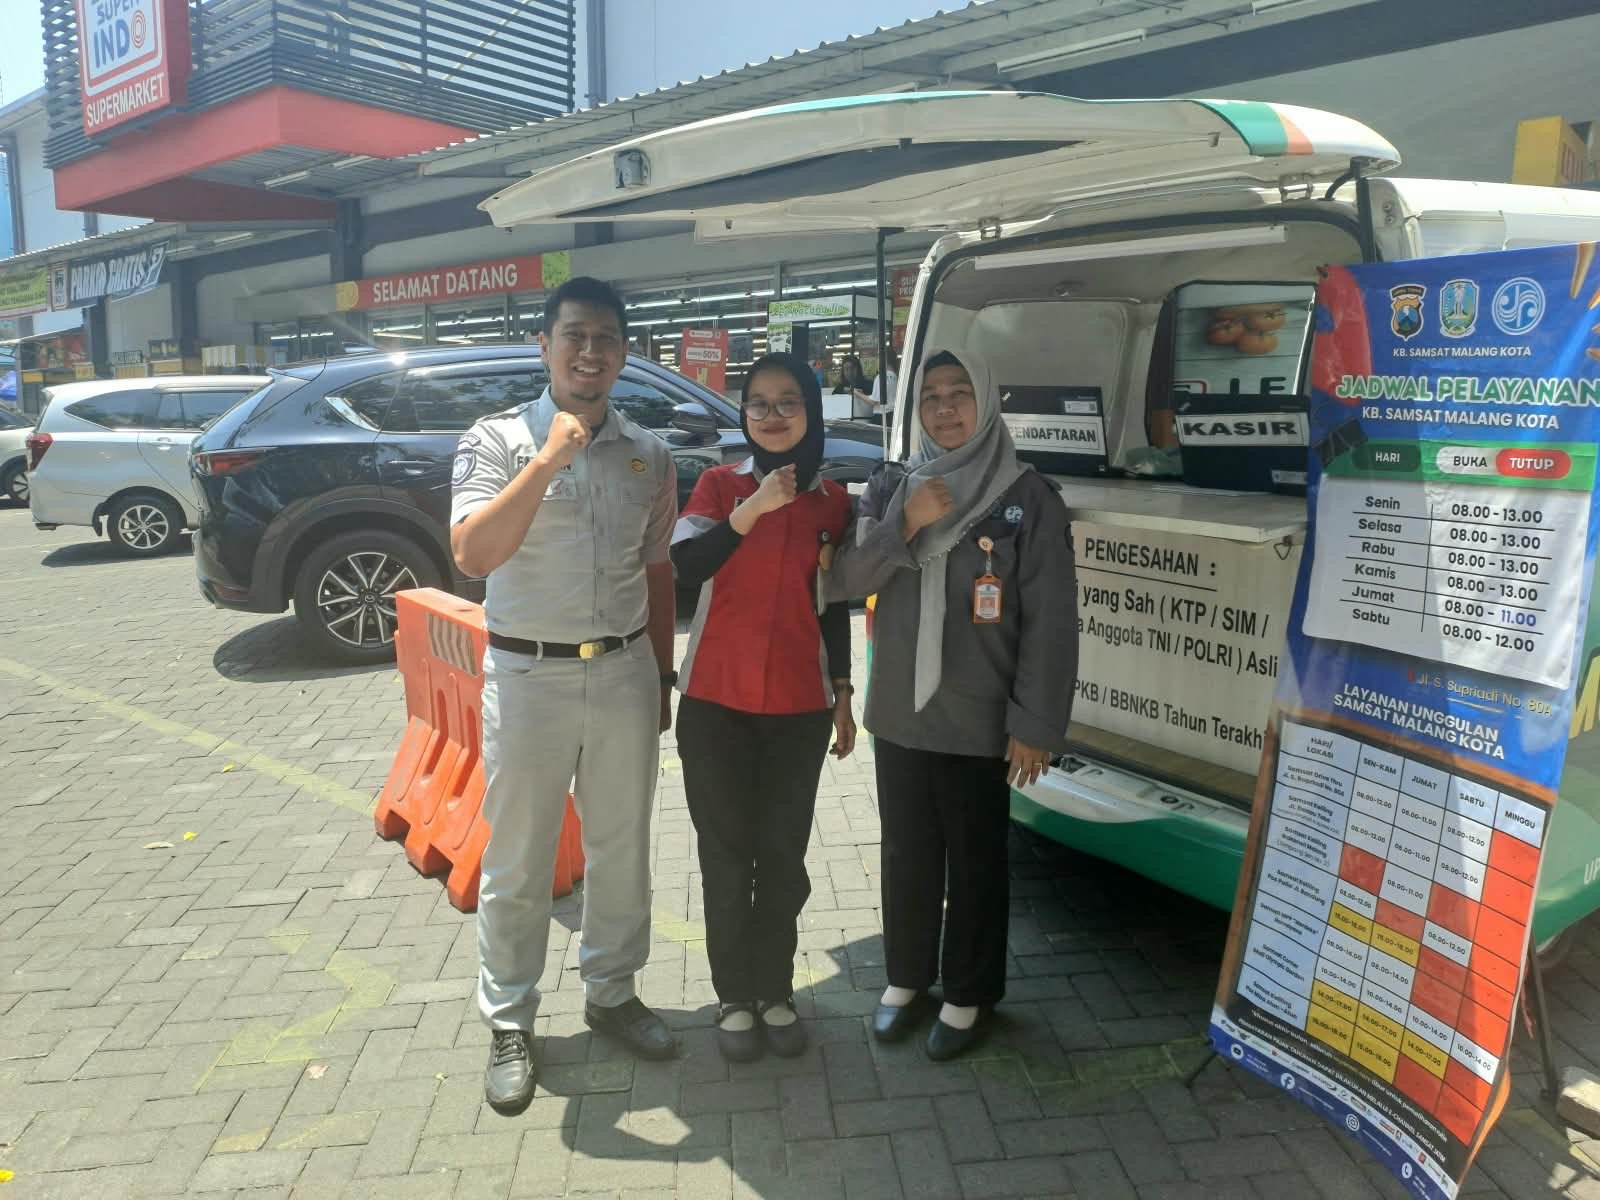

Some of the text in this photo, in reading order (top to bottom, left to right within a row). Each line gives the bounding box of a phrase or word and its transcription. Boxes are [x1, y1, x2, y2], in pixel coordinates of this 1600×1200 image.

[97, 0, 140, 25] SUPE
[87, 72, 164, 128] SUPERMARKET
[107, 253, 147, 294] GRATIS
[373, 264, 518, 303] SELAMAT DATANG
[1393, 346, 1532, 357] KB. SAMSAT MALANG KOTA
[1336, 374, 1600, 407] JADWAL PELAYANAN
[1183, 422, 1297, 435] KASIR
[1362, 407, 1559, 430] KB. SAMSAT MALANG KOTA
[1375, 452, 1400, 464] HARI
[1453, 456, 1488, 468] BUKA
[1510, 457, 1554, 470] TUTUP
[1365, 496, 1400, 510] Senin
[1452, 504, 1490, 519] 08.00
[1502, 508, 1543, 524] 13.00
[1358, 518, 1402, 534] Selasa
[1362, 542, 1395, 557] Rabu
[1450, 527, 1488, 544] 08.00
[1501, 533, 1541, 550] 13.00
[1085, 537, 1199, 577] PENGESAHAN
[1448, 552, 1486, 568] 08.00
[1500, 559, 1538, 575] 13.00
[1355, 563, 1396, 580] Kamis
[1352, 586, 1394, 603] Jumat
[1447, 576, 1485, 593] 08.00
[1499, 584, 1538, 601] 13.00
[1083, 585, 1119, 614] yang
[1125, 588, 1154, 615] Sah
[1171, 597, 1207, 625] KTP
[1222, 607, 1256, 636] SIM
[1352, 608, 1390, 626] Sabtu
[1445, 600, 1484, 618] 08.00
[1501, 609, 1537, 627] 11.00
[1087, 615, 1143, 647] Anggota
[1147, 628, 1171, 653] TNI
[1184, 636, 1232, 667] POLRI
[1246, 650, 1278, 678] Asli
[1442, 624, 1482, 642] 08.00
[1495, 634, 1535, 652] 12.00
[1447, 680, 1499, 702] Supriadi
[1528, 699, 1553, 716] 80A
[1110, 688, 1159, 719] BBNKB
[1164, 703, 1206, 734] Tahun
[1212, 716, 1264, 750] Terakh
[1344, 683, 1498, 742] LAYANAN UNGGULAN
[1334, 694, 1505, 760] SAMSAT MALANG KOTA
[1363, 757, 1397, 775] SEN-KAM
[1411, 775, 1437, 791] JUMAT
[1459, 792, 1485, 808] SABTU
[1505, 810, 1536, 829] MINGGU
